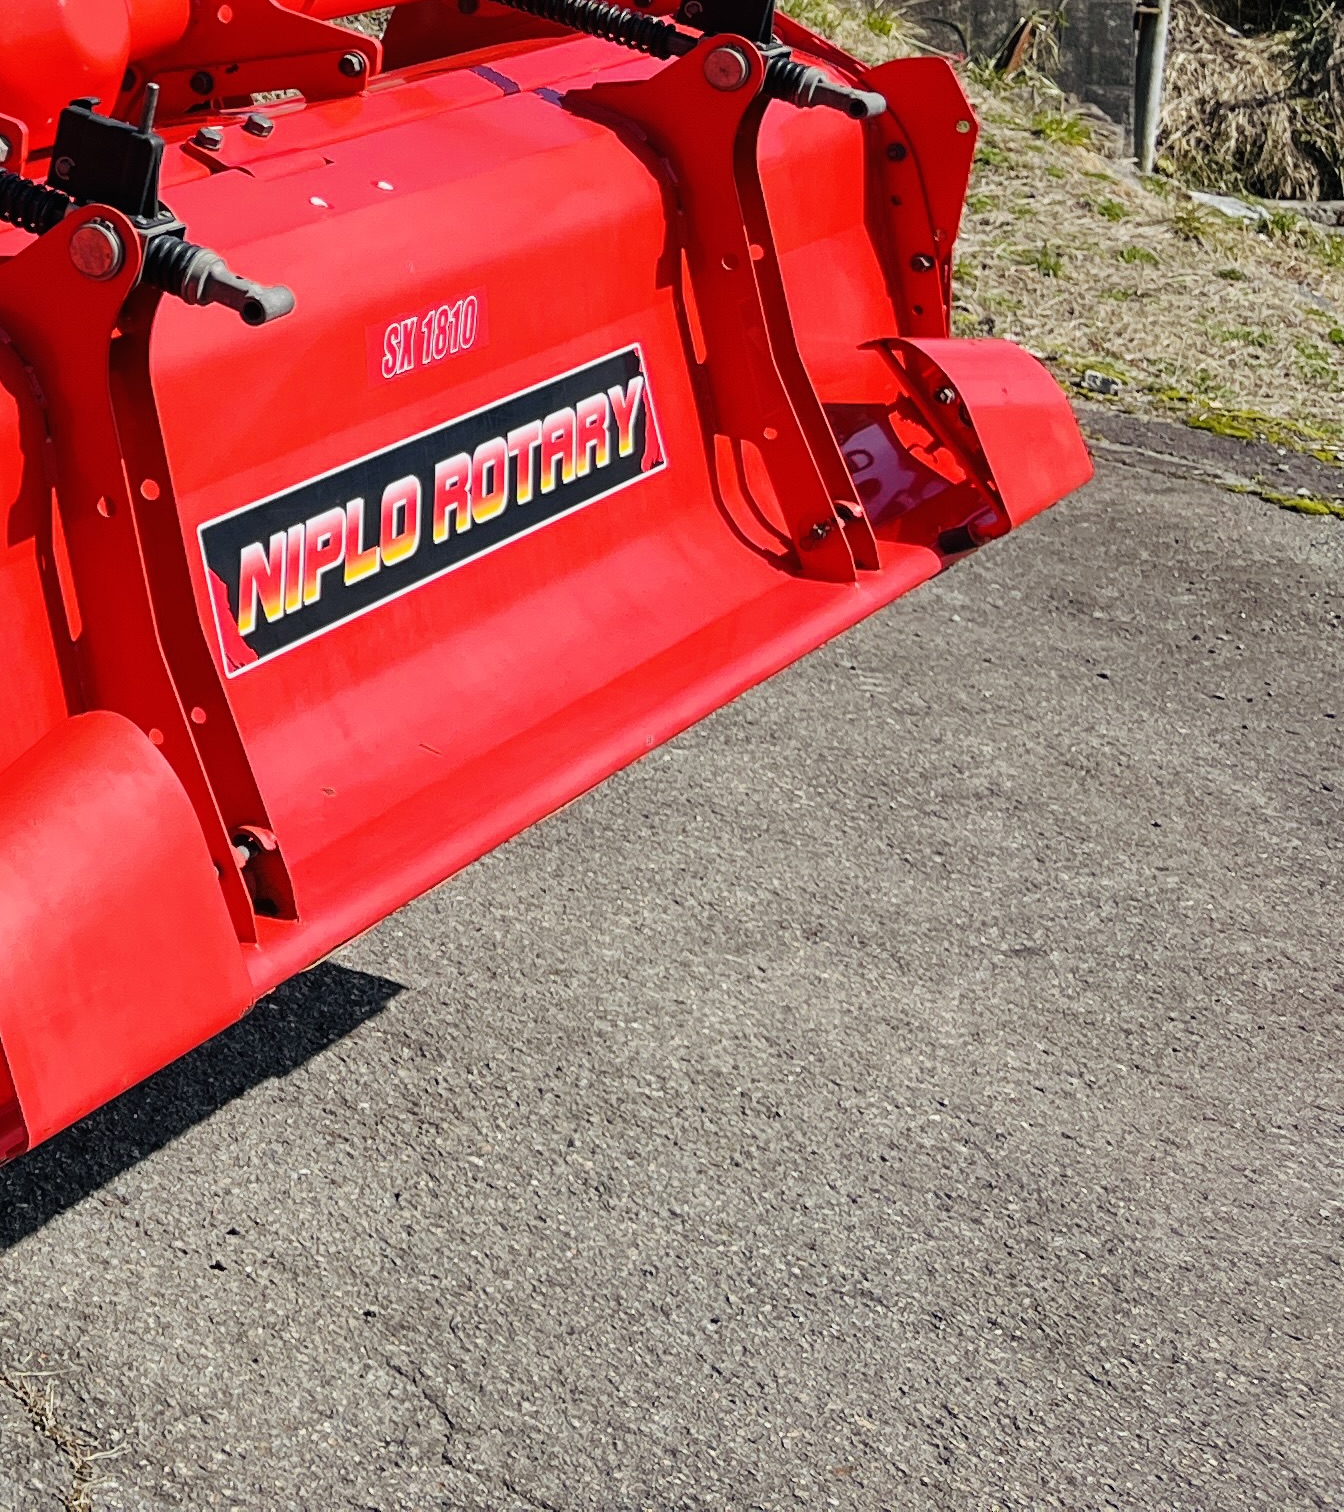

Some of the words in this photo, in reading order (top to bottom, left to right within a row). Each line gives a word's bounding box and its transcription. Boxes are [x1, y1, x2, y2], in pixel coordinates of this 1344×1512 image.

[381, 316, 417, 379] SX
[421, 295, 478, 365] 1810
[238, 474, 421, 637] NIPLO
[433, 376, 645, 545] ROTARY
